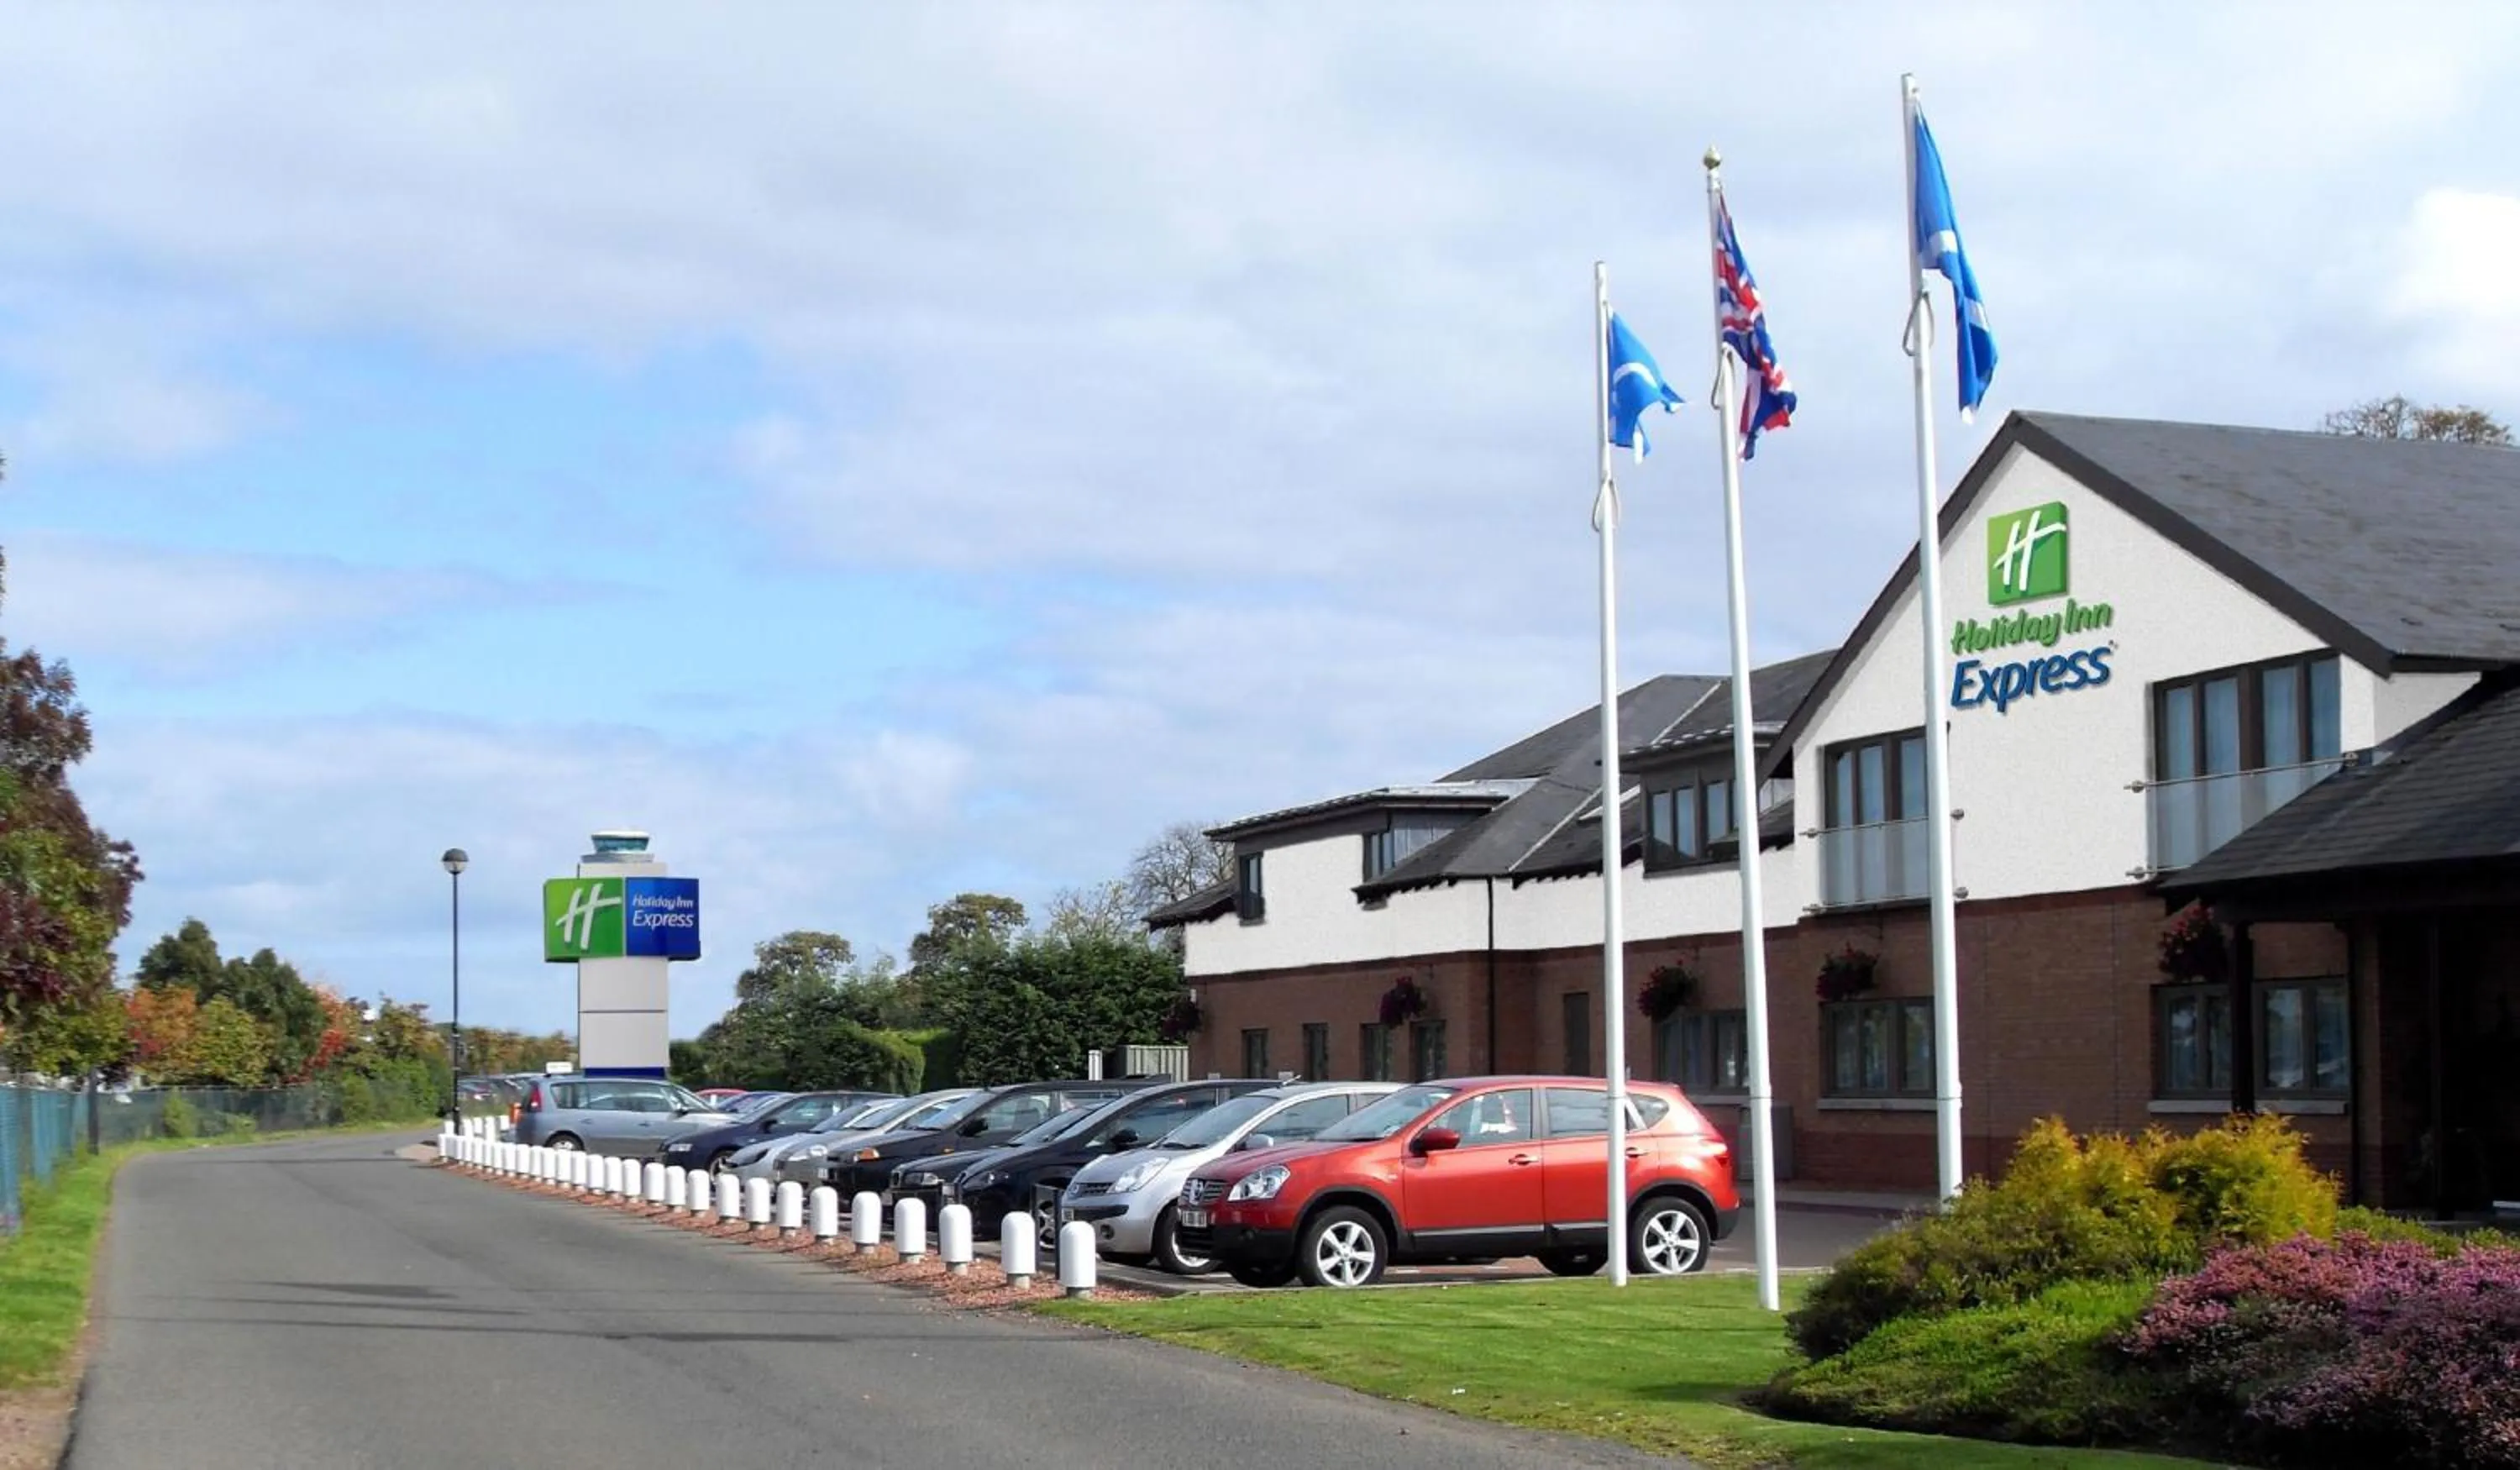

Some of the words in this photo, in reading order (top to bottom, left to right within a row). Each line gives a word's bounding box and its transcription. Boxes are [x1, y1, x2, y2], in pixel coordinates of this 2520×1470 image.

[1994, 510, 2066, 591] H
[1951, 609, 2061, 654] Holiday
[2063, 598, 2113, 634] Inn
[1951, 647, 2111, 712] Express
[555, 884, 622, 949] H
[633, 894, 675, 911] Holiday
[676, 895, 693, 907] Inn
[633, 910, 694, 930] Express
